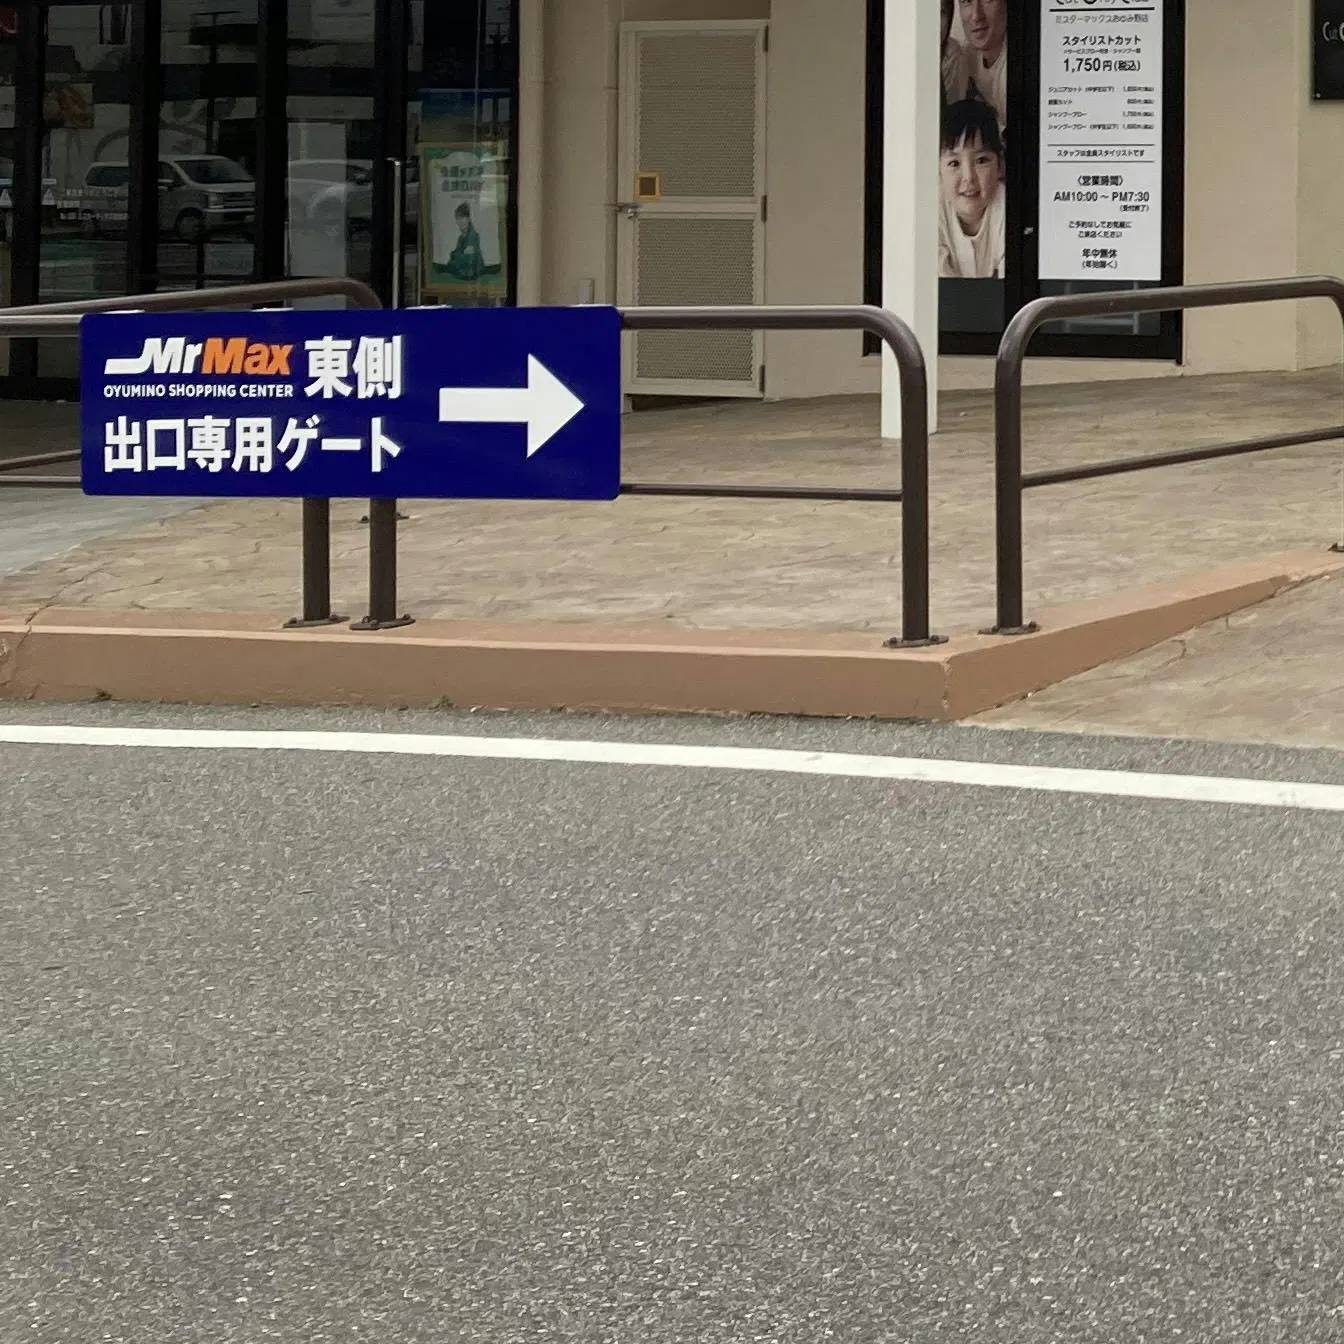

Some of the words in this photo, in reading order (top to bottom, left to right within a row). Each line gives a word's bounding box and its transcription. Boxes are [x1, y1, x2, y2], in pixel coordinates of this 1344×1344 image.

[1063, 35, 1142, 46] スタイリストカット
[104, 336, 294, 376] MrMax
[304, 335, 404, 400] 東側
[103, 383, 166, 399] OYUMINO
[168, 383, 236, 399] SHOPPING
[239, 383, 294, 399] CENTER
[103, 413, 403, 474] 出口専用ゲート
